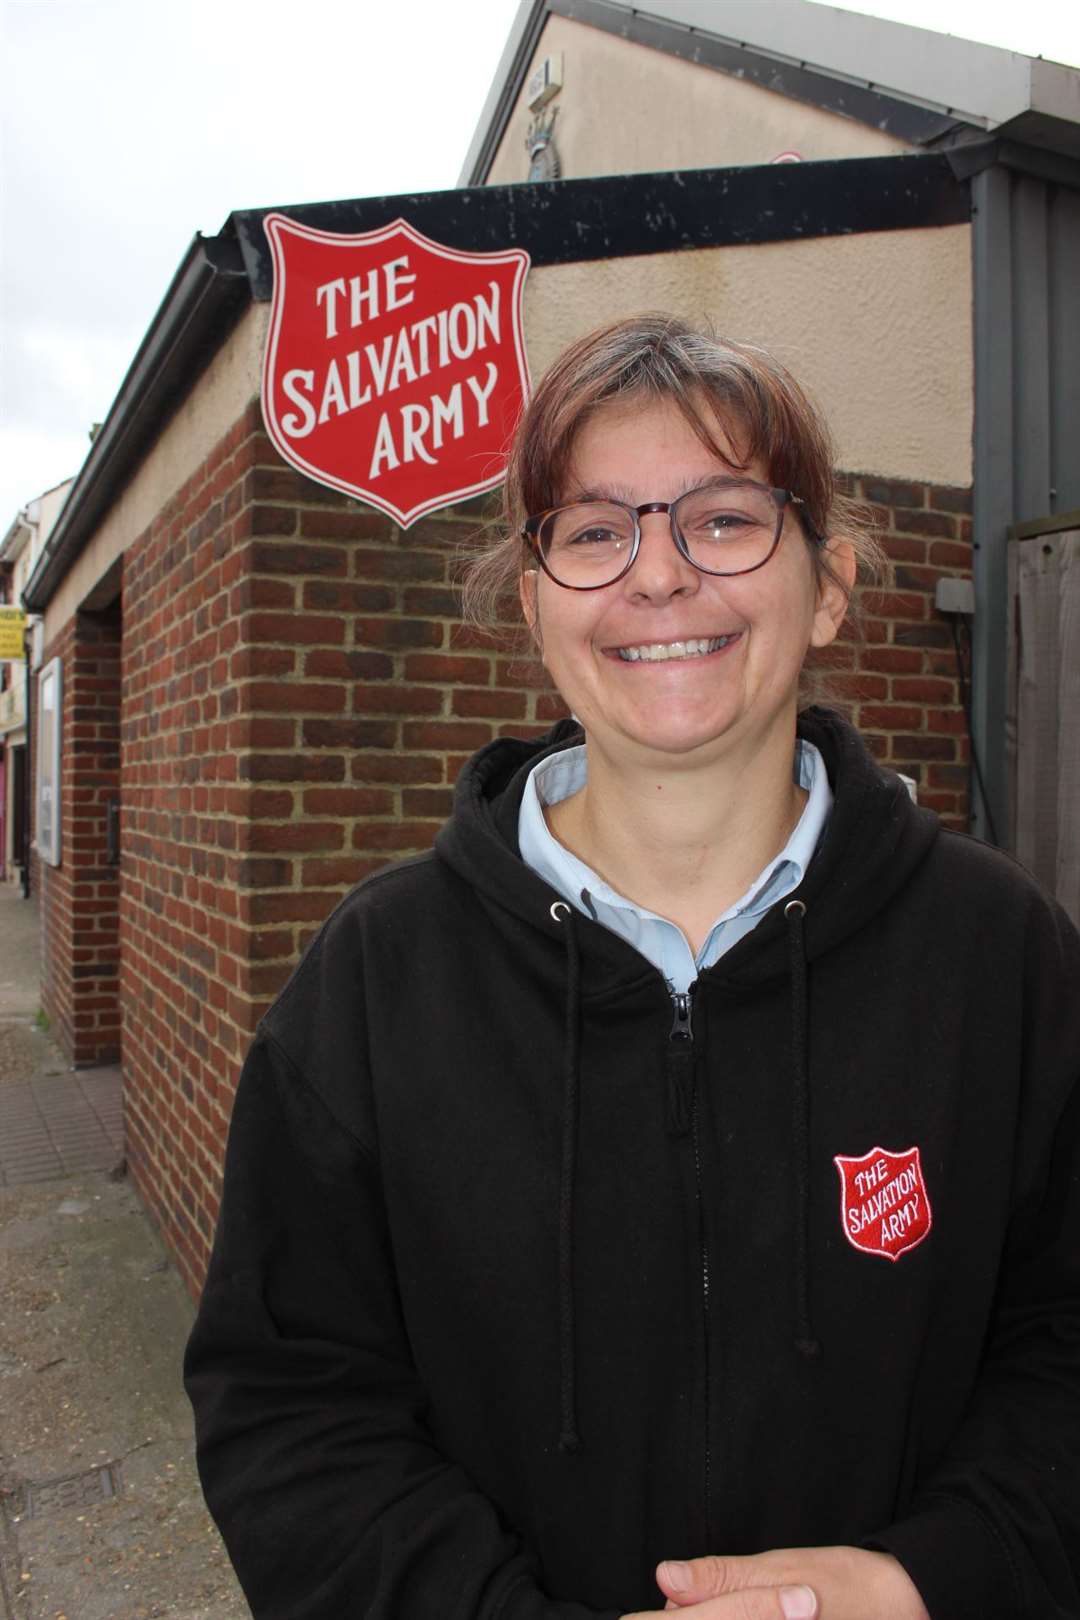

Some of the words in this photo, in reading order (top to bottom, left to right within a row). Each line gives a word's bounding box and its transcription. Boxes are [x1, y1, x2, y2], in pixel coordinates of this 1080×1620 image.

[316, 255, 417, 339] THE
[281, 281, 501, 439] SALVATION
[368, 362, 498, 480] ARMY
[848, 1162, 918, 1234] SALVATION
[854, 1159, 888, 1197] THE
[881, 1193, 919, 1247] ARMY
